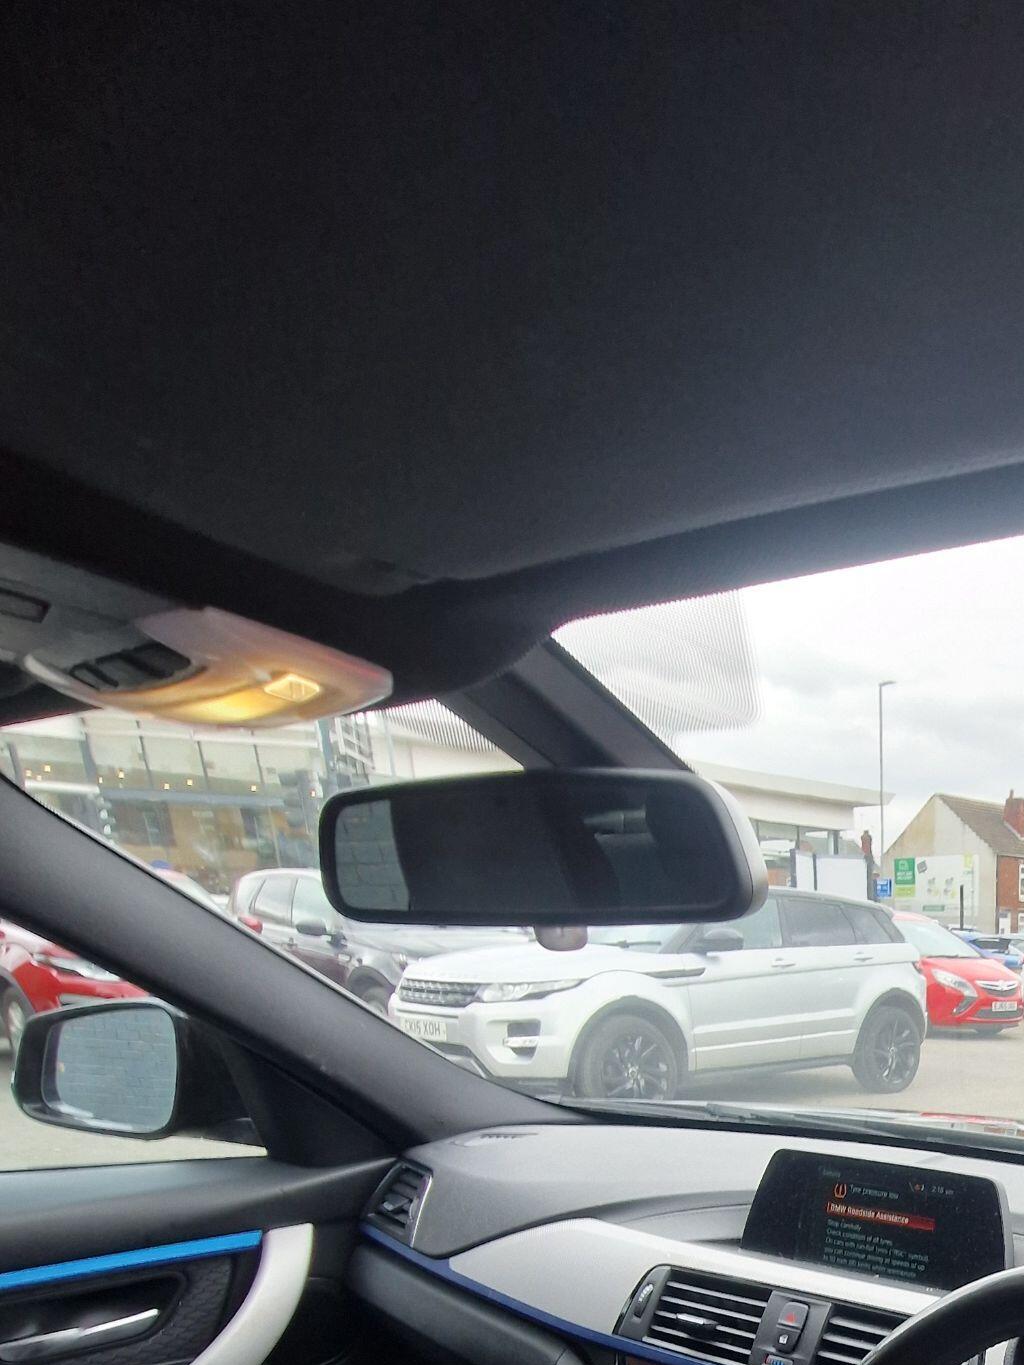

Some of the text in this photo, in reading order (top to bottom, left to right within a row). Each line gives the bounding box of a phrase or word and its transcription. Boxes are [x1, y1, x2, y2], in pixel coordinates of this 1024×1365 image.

[830, 1203, 909, 1224] BMW Roadside Assistance
